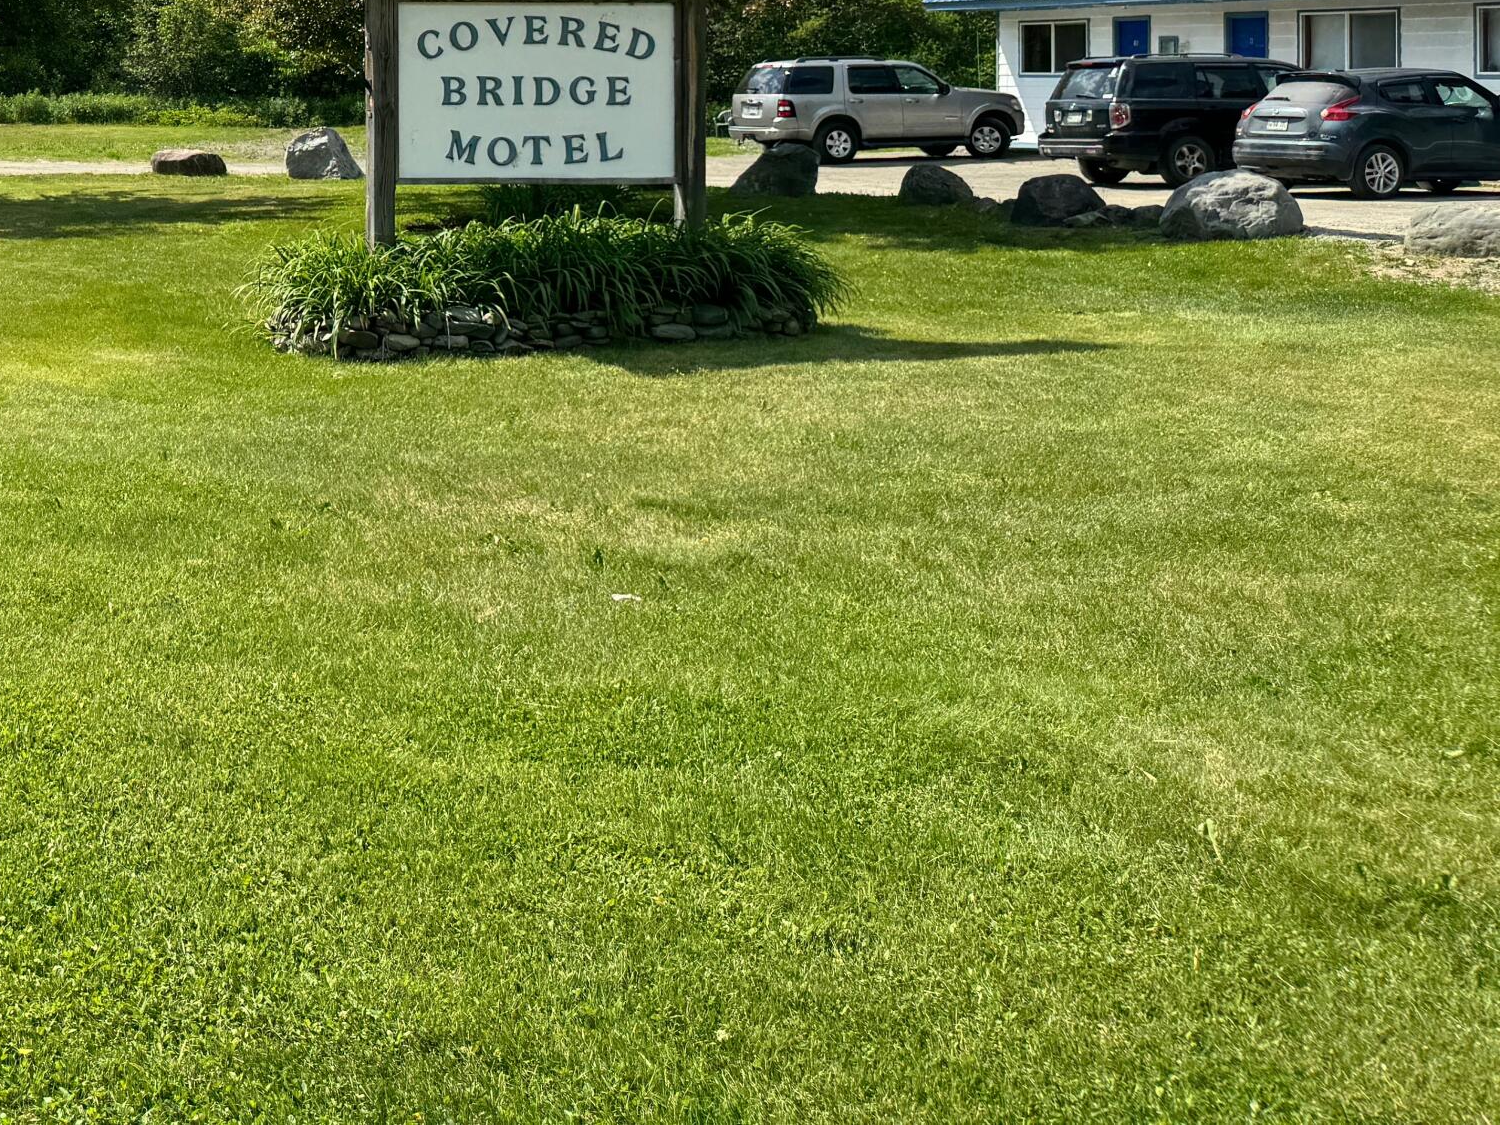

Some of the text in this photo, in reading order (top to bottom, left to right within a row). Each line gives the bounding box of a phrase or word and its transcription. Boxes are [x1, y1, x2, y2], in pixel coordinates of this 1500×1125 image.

[417, 15, 656, 60] COVERED
[440, 75, 632, 106] BRIDGE
[445, 129, 624, 166] MOTEL
